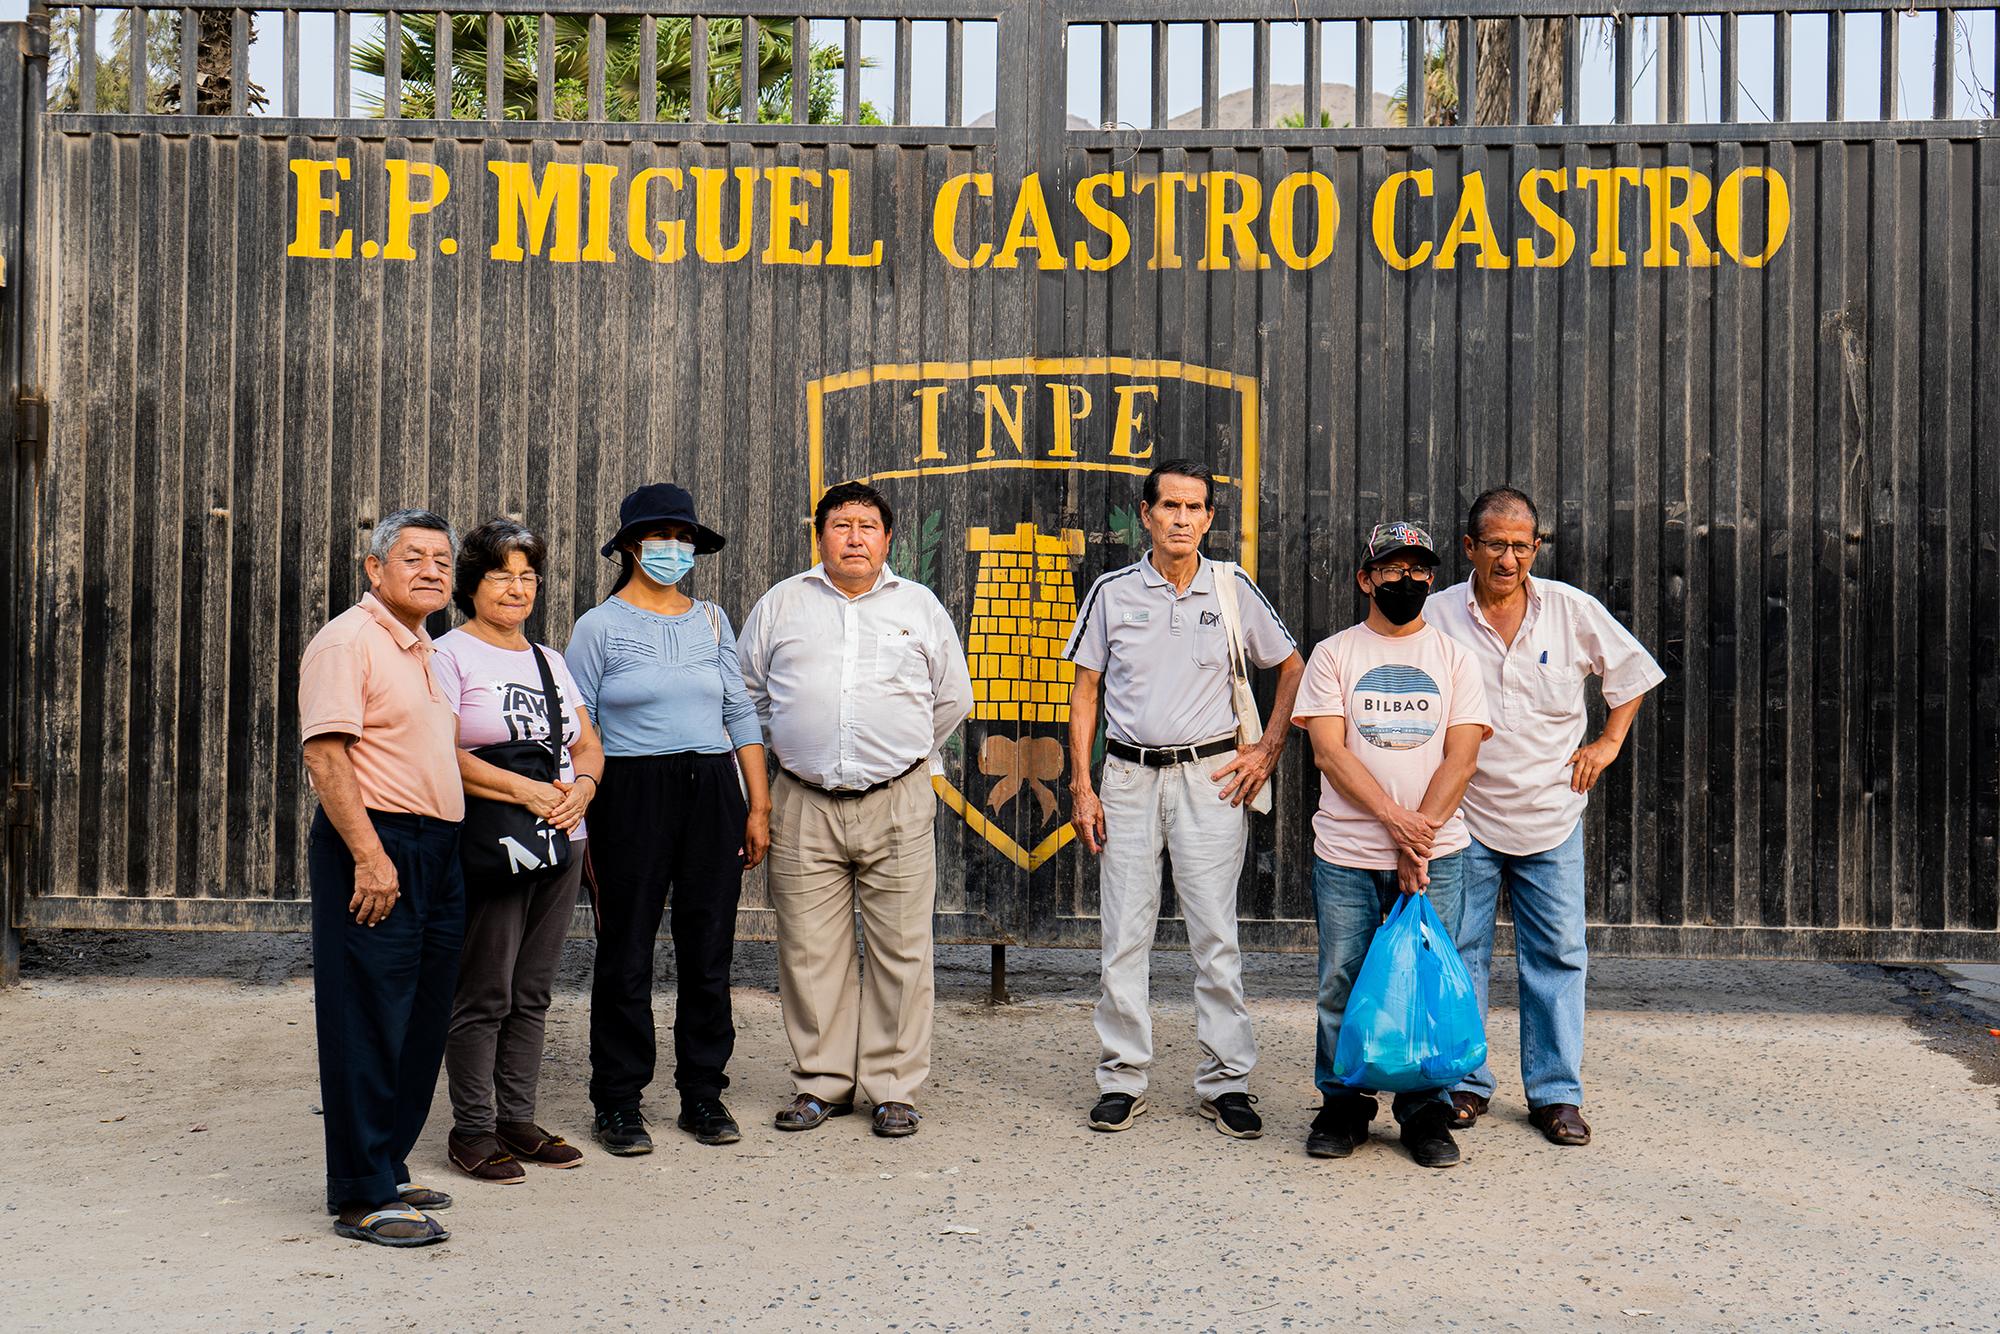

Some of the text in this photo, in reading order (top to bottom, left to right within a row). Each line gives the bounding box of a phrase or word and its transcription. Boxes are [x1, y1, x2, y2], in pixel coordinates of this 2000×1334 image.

[286, 157, 1791, 271] E.P. MIGUEL CASTRO CASTRO
[912, 382, 1159, 463] INPE
[502, 682, 566, 722] TAK
[1364, 698, 1429, 712] BILBAO
